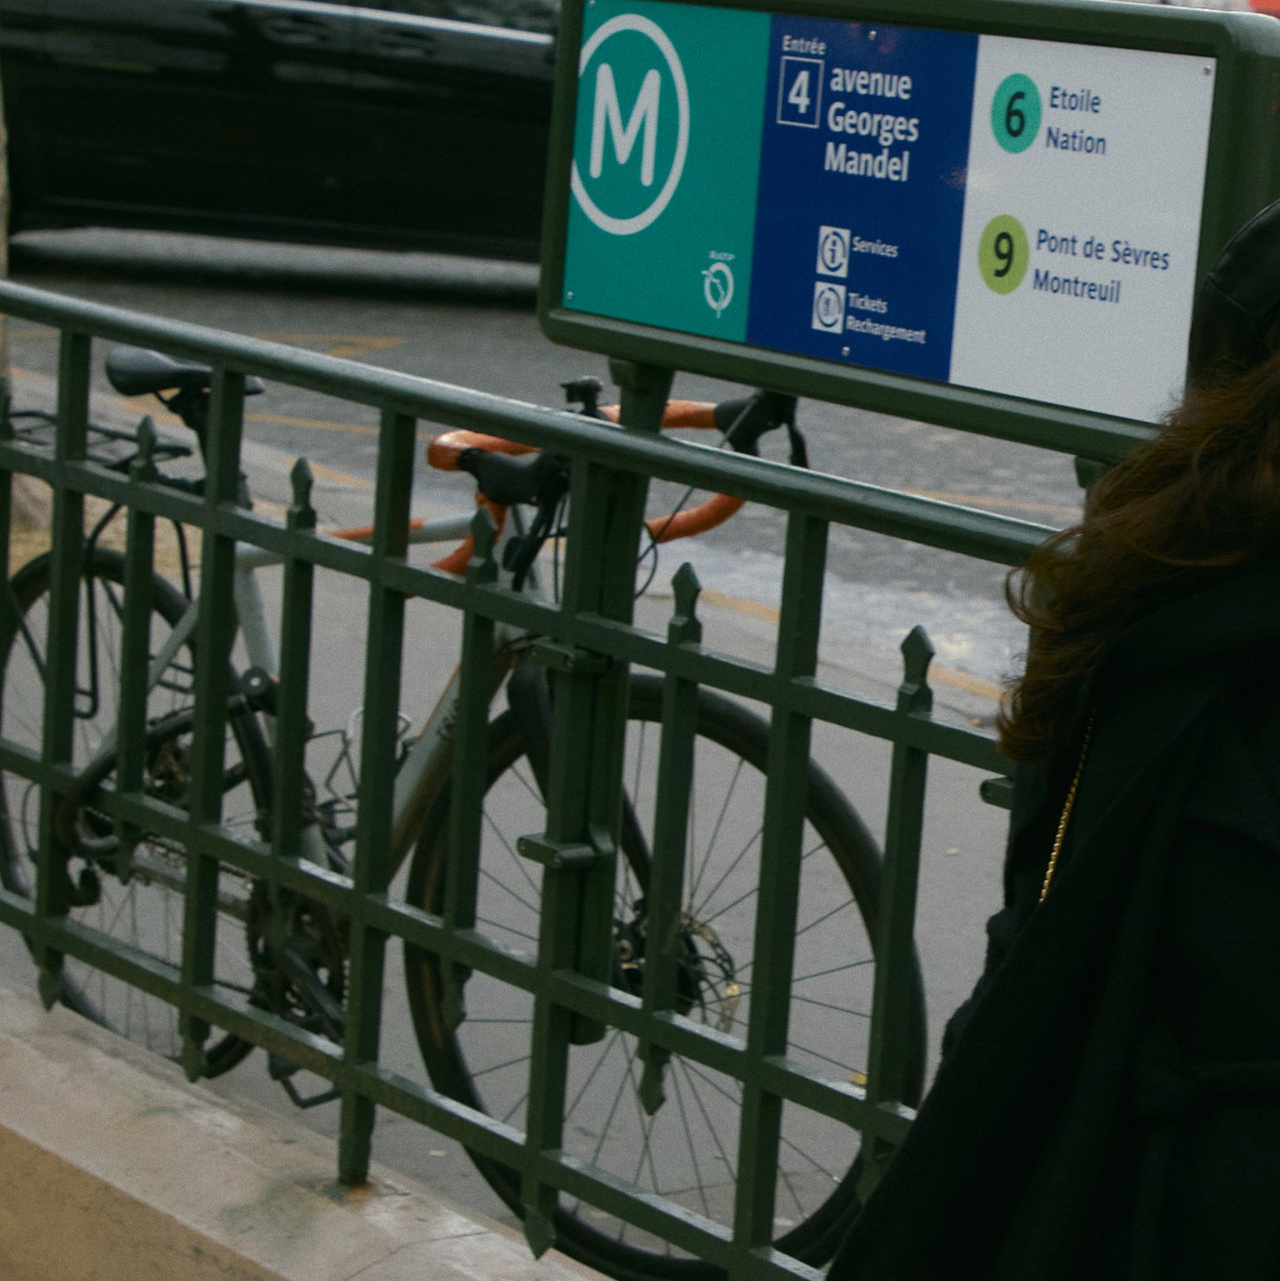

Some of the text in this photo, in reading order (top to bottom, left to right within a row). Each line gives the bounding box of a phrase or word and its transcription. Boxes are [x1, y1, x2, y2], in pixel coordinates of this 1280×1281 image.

[782, 35, 826, 55] Entrée
[788, 70, 811, 114] 4
[830, 67, 912, 100] avenue
[1050, 86, 1101, 113] Etoile
[589, 62, 662, 187] M
[827, 101, 919, 146] Georges
[1005, 91, 1026, 138] 6
[1046, 126, 1107, 155] Nation
[824, 141, 910, 182] Mandel
[852, 236, 898, 258] Services
[993, 232, 1015, 278] 9
[1037, 229, 1170, 271] Pont de Sèvres
[848, 292, 888, 314] Tickets
[1033, 268, 1122, 303] Montreuil
[846, 315, 926, 344] Rechargement
